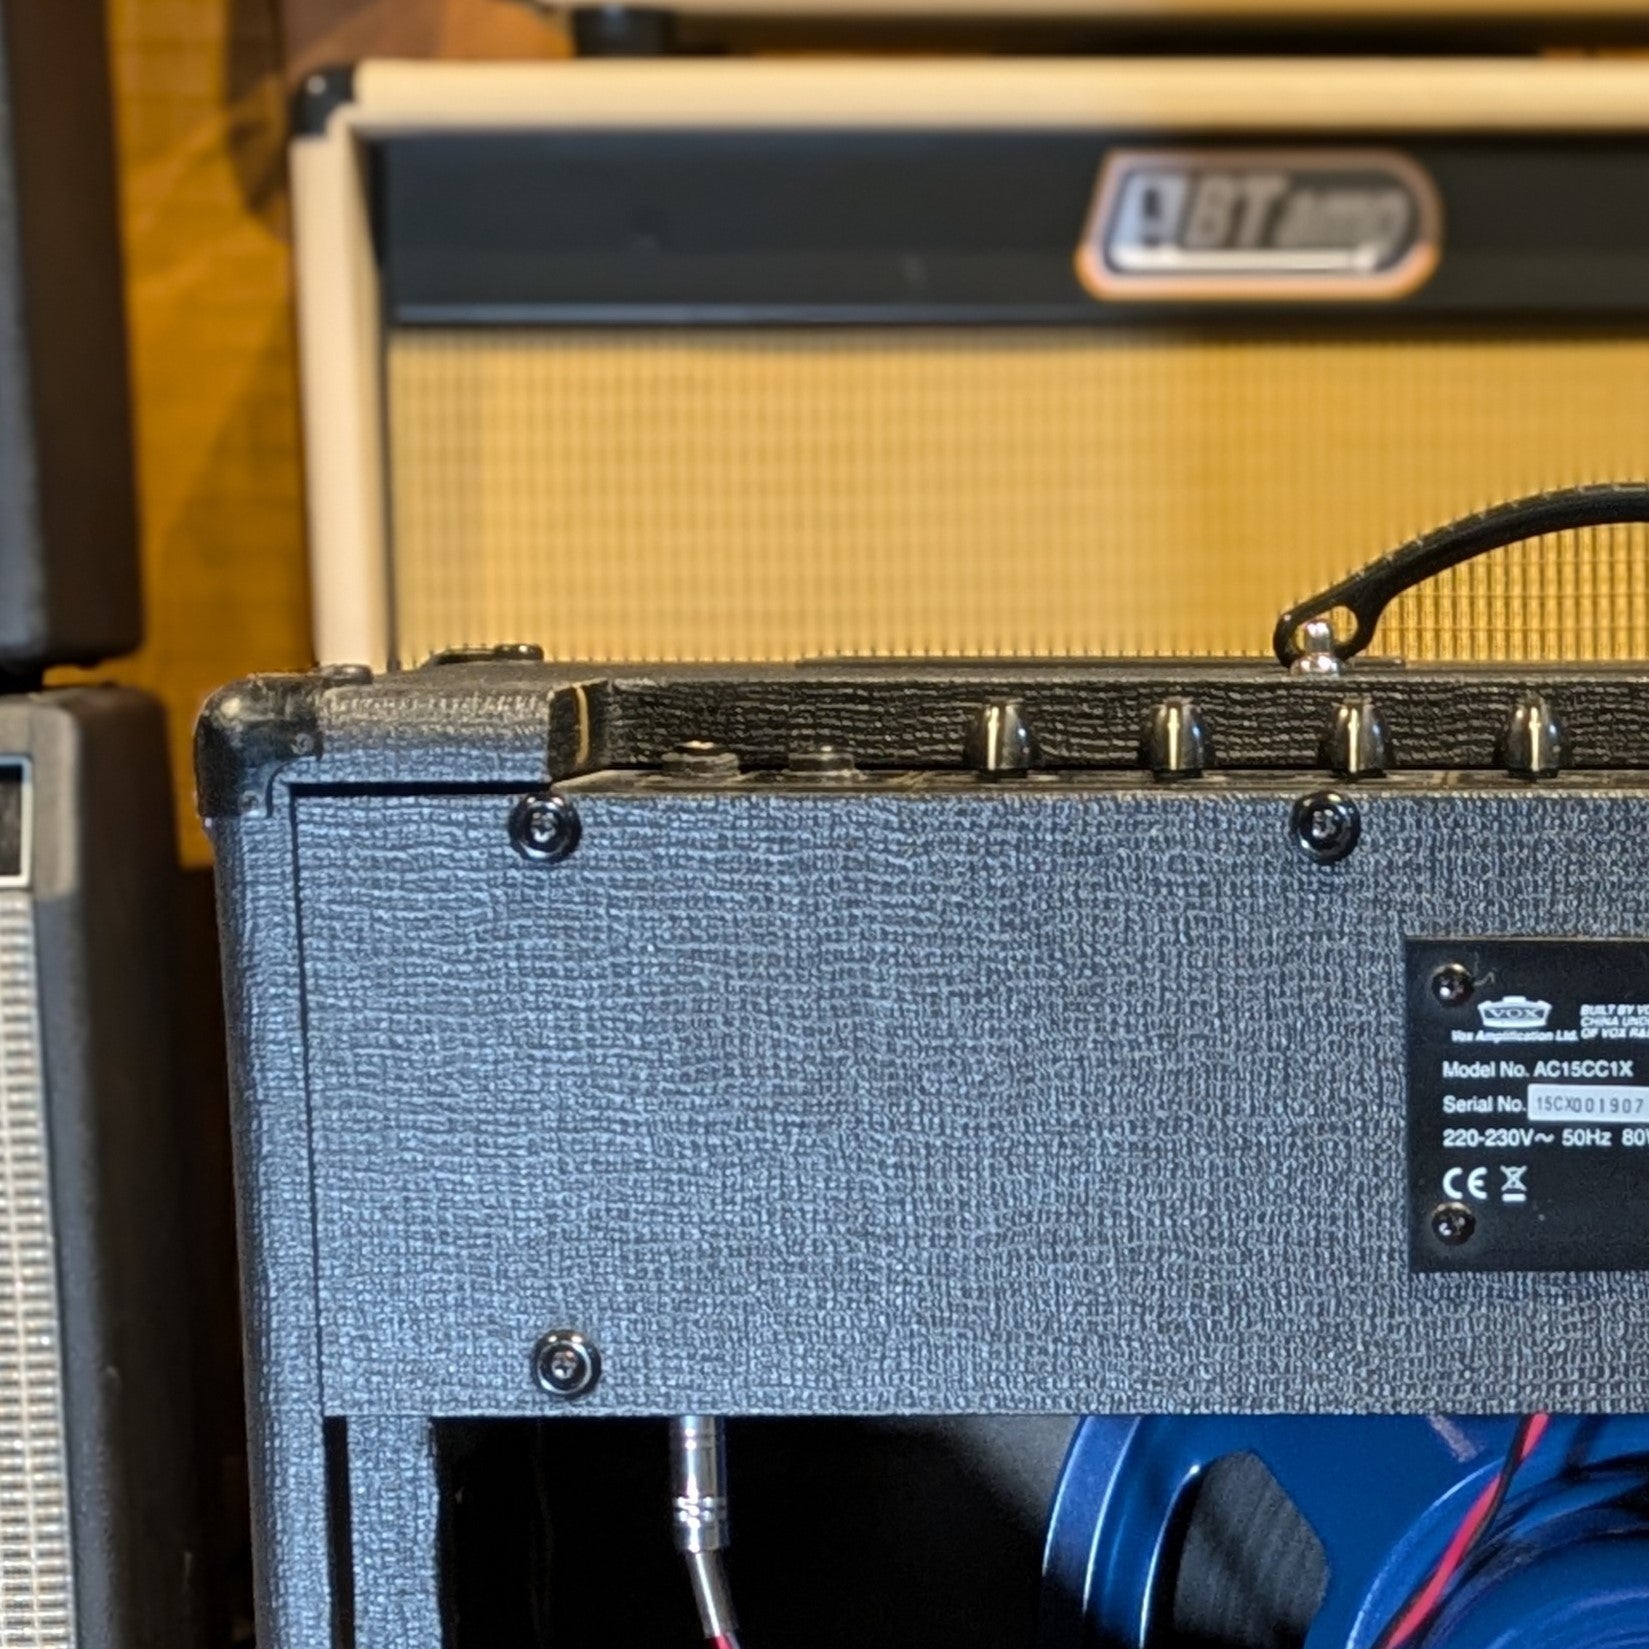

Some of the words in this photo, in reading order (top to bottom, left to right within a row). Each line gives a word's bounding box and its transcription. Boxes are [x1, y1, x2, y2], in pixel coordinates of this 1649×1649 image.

[1488, 1008, 1539, 1019] VOX
[1580, 1003, 1615, 1016] BUILT
[1617, 1003, 1635, 1016] BY
[1580, 1016, 1619, 1027] CHINA
[1451, 1030, 1474, 1042] Vox
[1475, 1030, 1554, 1044] Amplification
[1555, 1030, 1579, 1042] Ltd.
[1580, 1028, 1600, 1039] OF
[1601, 1028, 1627, 1039] VOX
[1442, 1060, 1496, 1078] Model
[1499, 1060, 1531, 1078] No.
[1533, 1060, 1634, 1078] AC15CC1X
[1442, 1094, 1494, 1113] Serial
[1497, 1095, 1527, 1113] No.
[1537, 1096, 1645, 1114] 15CX001907
[1561, 1127, 1613, 1147] 50Hz
